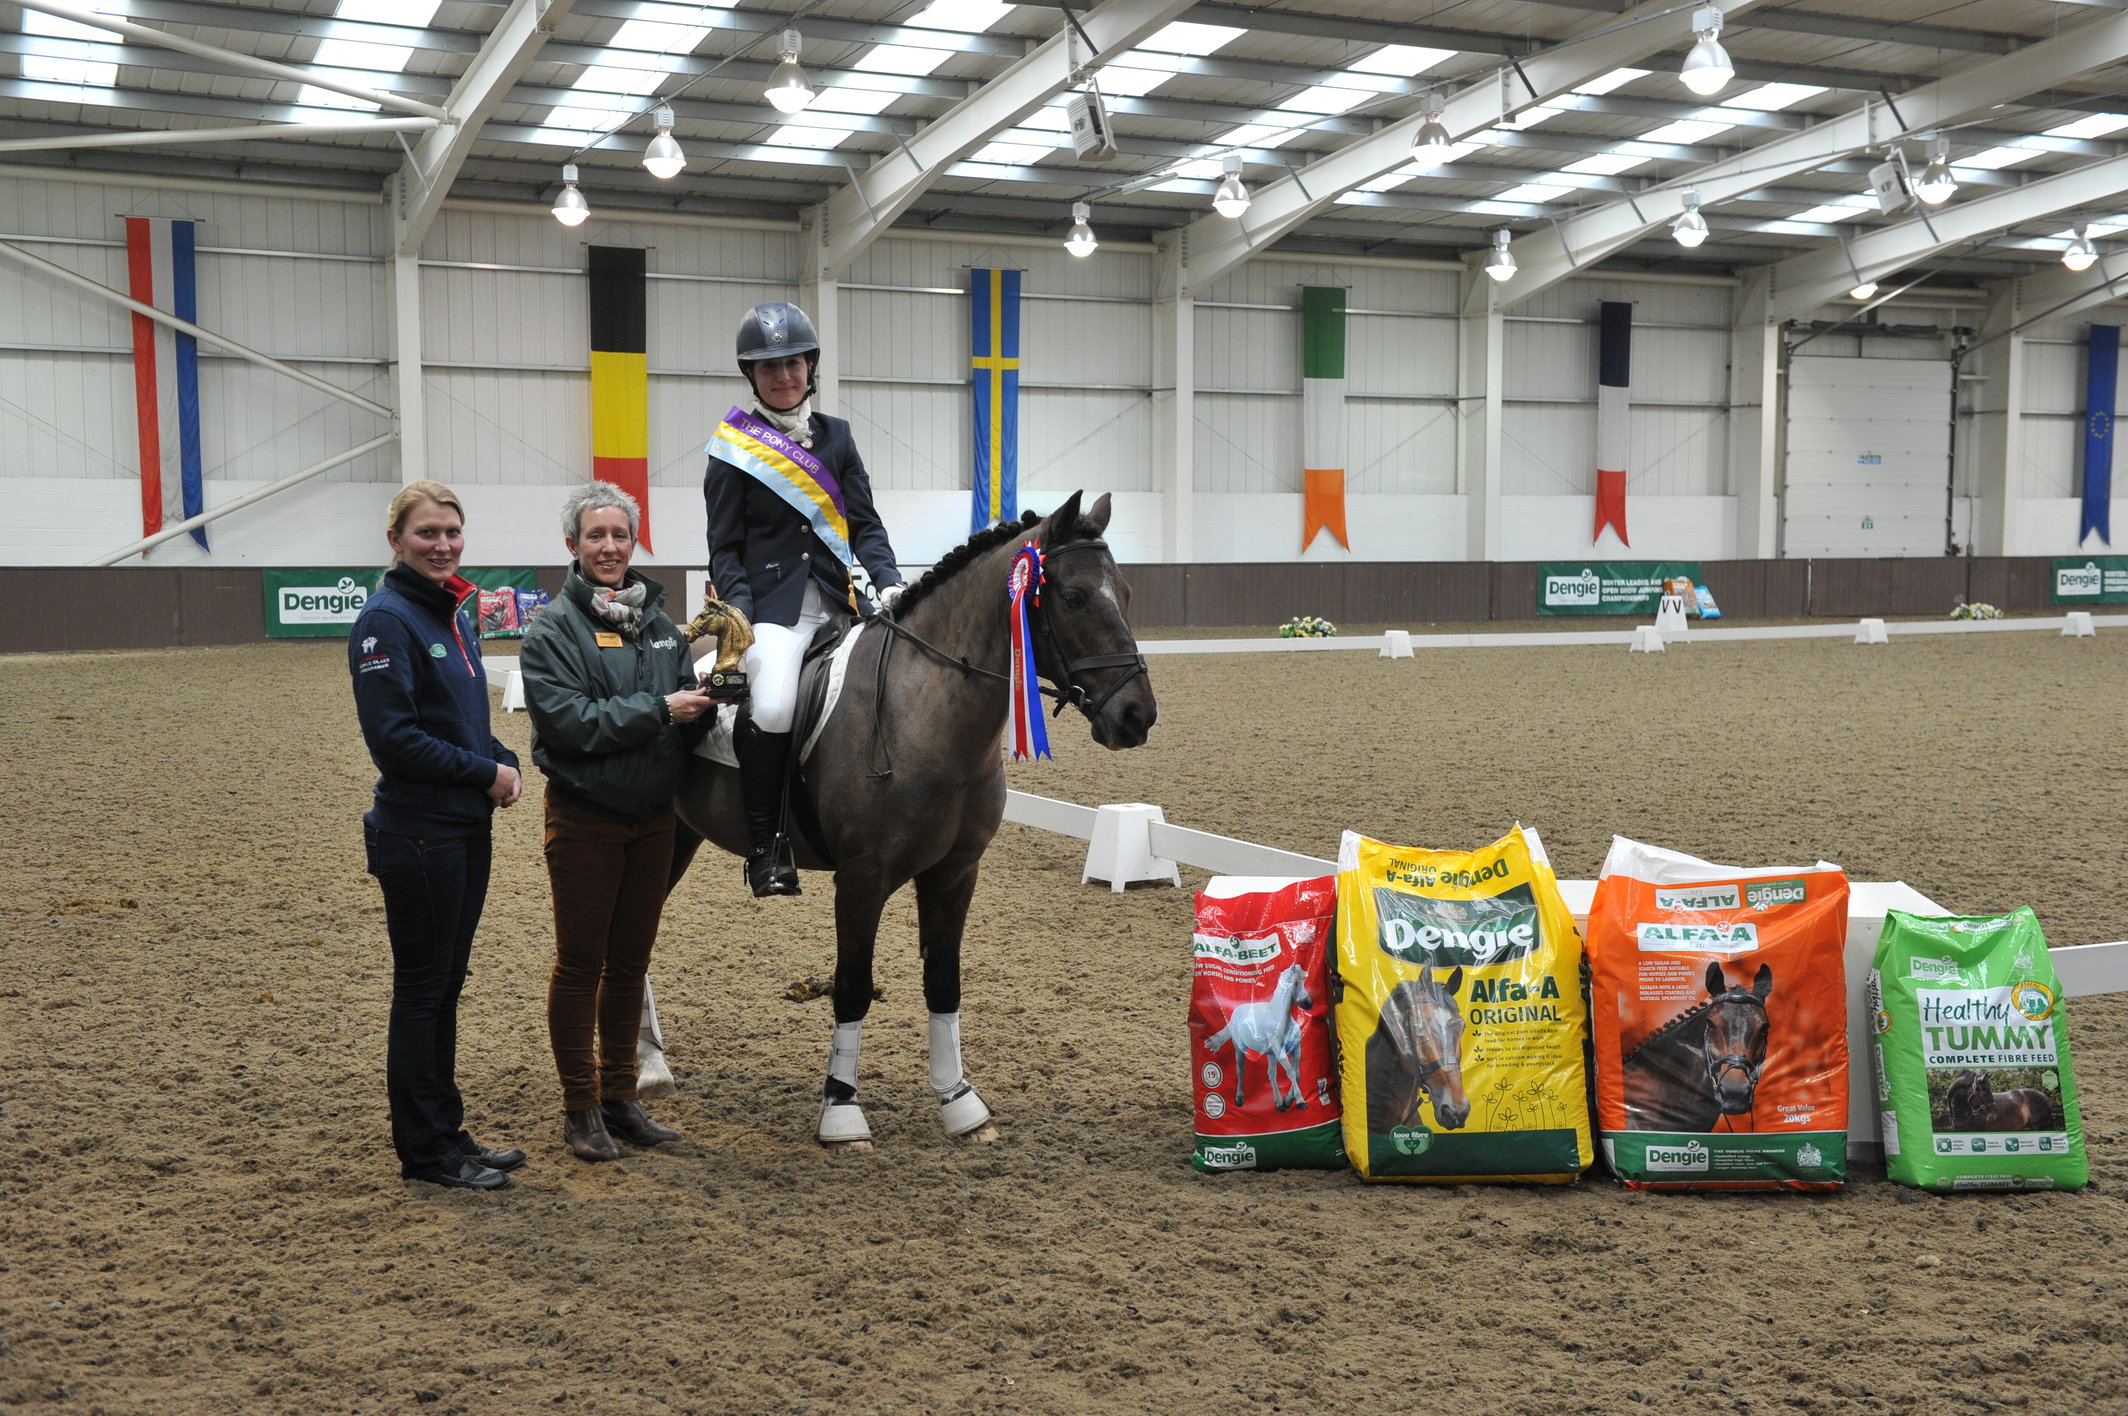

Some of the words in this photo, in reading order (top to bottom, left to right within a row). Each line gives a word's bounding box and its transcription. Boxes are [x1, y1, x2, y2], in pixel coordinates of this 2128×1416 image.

[741, 419, 762, 436] THE
[762, 432, 793, 452] PONY
[793, 450, 819, 474] CLUB
[2061, 574, 2099, 588] Dengie
[1549, 582, 1597, 597] Dengie
[284, 593, 364, 614] Dengie
[1389, 858, 1437, 874] ORIGINAL
[1440, 858, 1510, 888] Dengie
[1386, 870, 1436, 888] Alfa-A
[1659, 895, 1735, 908] ALFA-A
[1748, 887, 1804, 902] Dengie
[1385, 918, 1534, 960] Dengie
[1643, 927, 1752, 942] ALFA-A
[1194, 943, 1276, 960] ALFA-BEET
[1223, 968, 1262, 976] CONDITIONING
[1264, 964, 1275, 973] FEED
[1913, 960, 1957, 975] Dengie
[1470, 976, 1560, 1003] Alfa-A
[1470, 1005, 1562, 1025] ORIGINAL
[1924, 996, 2010, 1027] Healthy
[1926, 1025, 2048, 1051] TUMMY
[1929, 1055, 1995, 1064] COMPLETE
[1998, 1054, 2028, 1063] FIBRE
[2031, 1054, 2055, 1062] FEED
[1778, 1104, 1796, 1112] Great
[1798, 1104, 1816, 1112] Value
[1784, 1114, 1812, 1124] 20kgs
[1207, 1151, 1254, 1164] Dengie
[1650, 1150, 1707, 1165] Dengie
